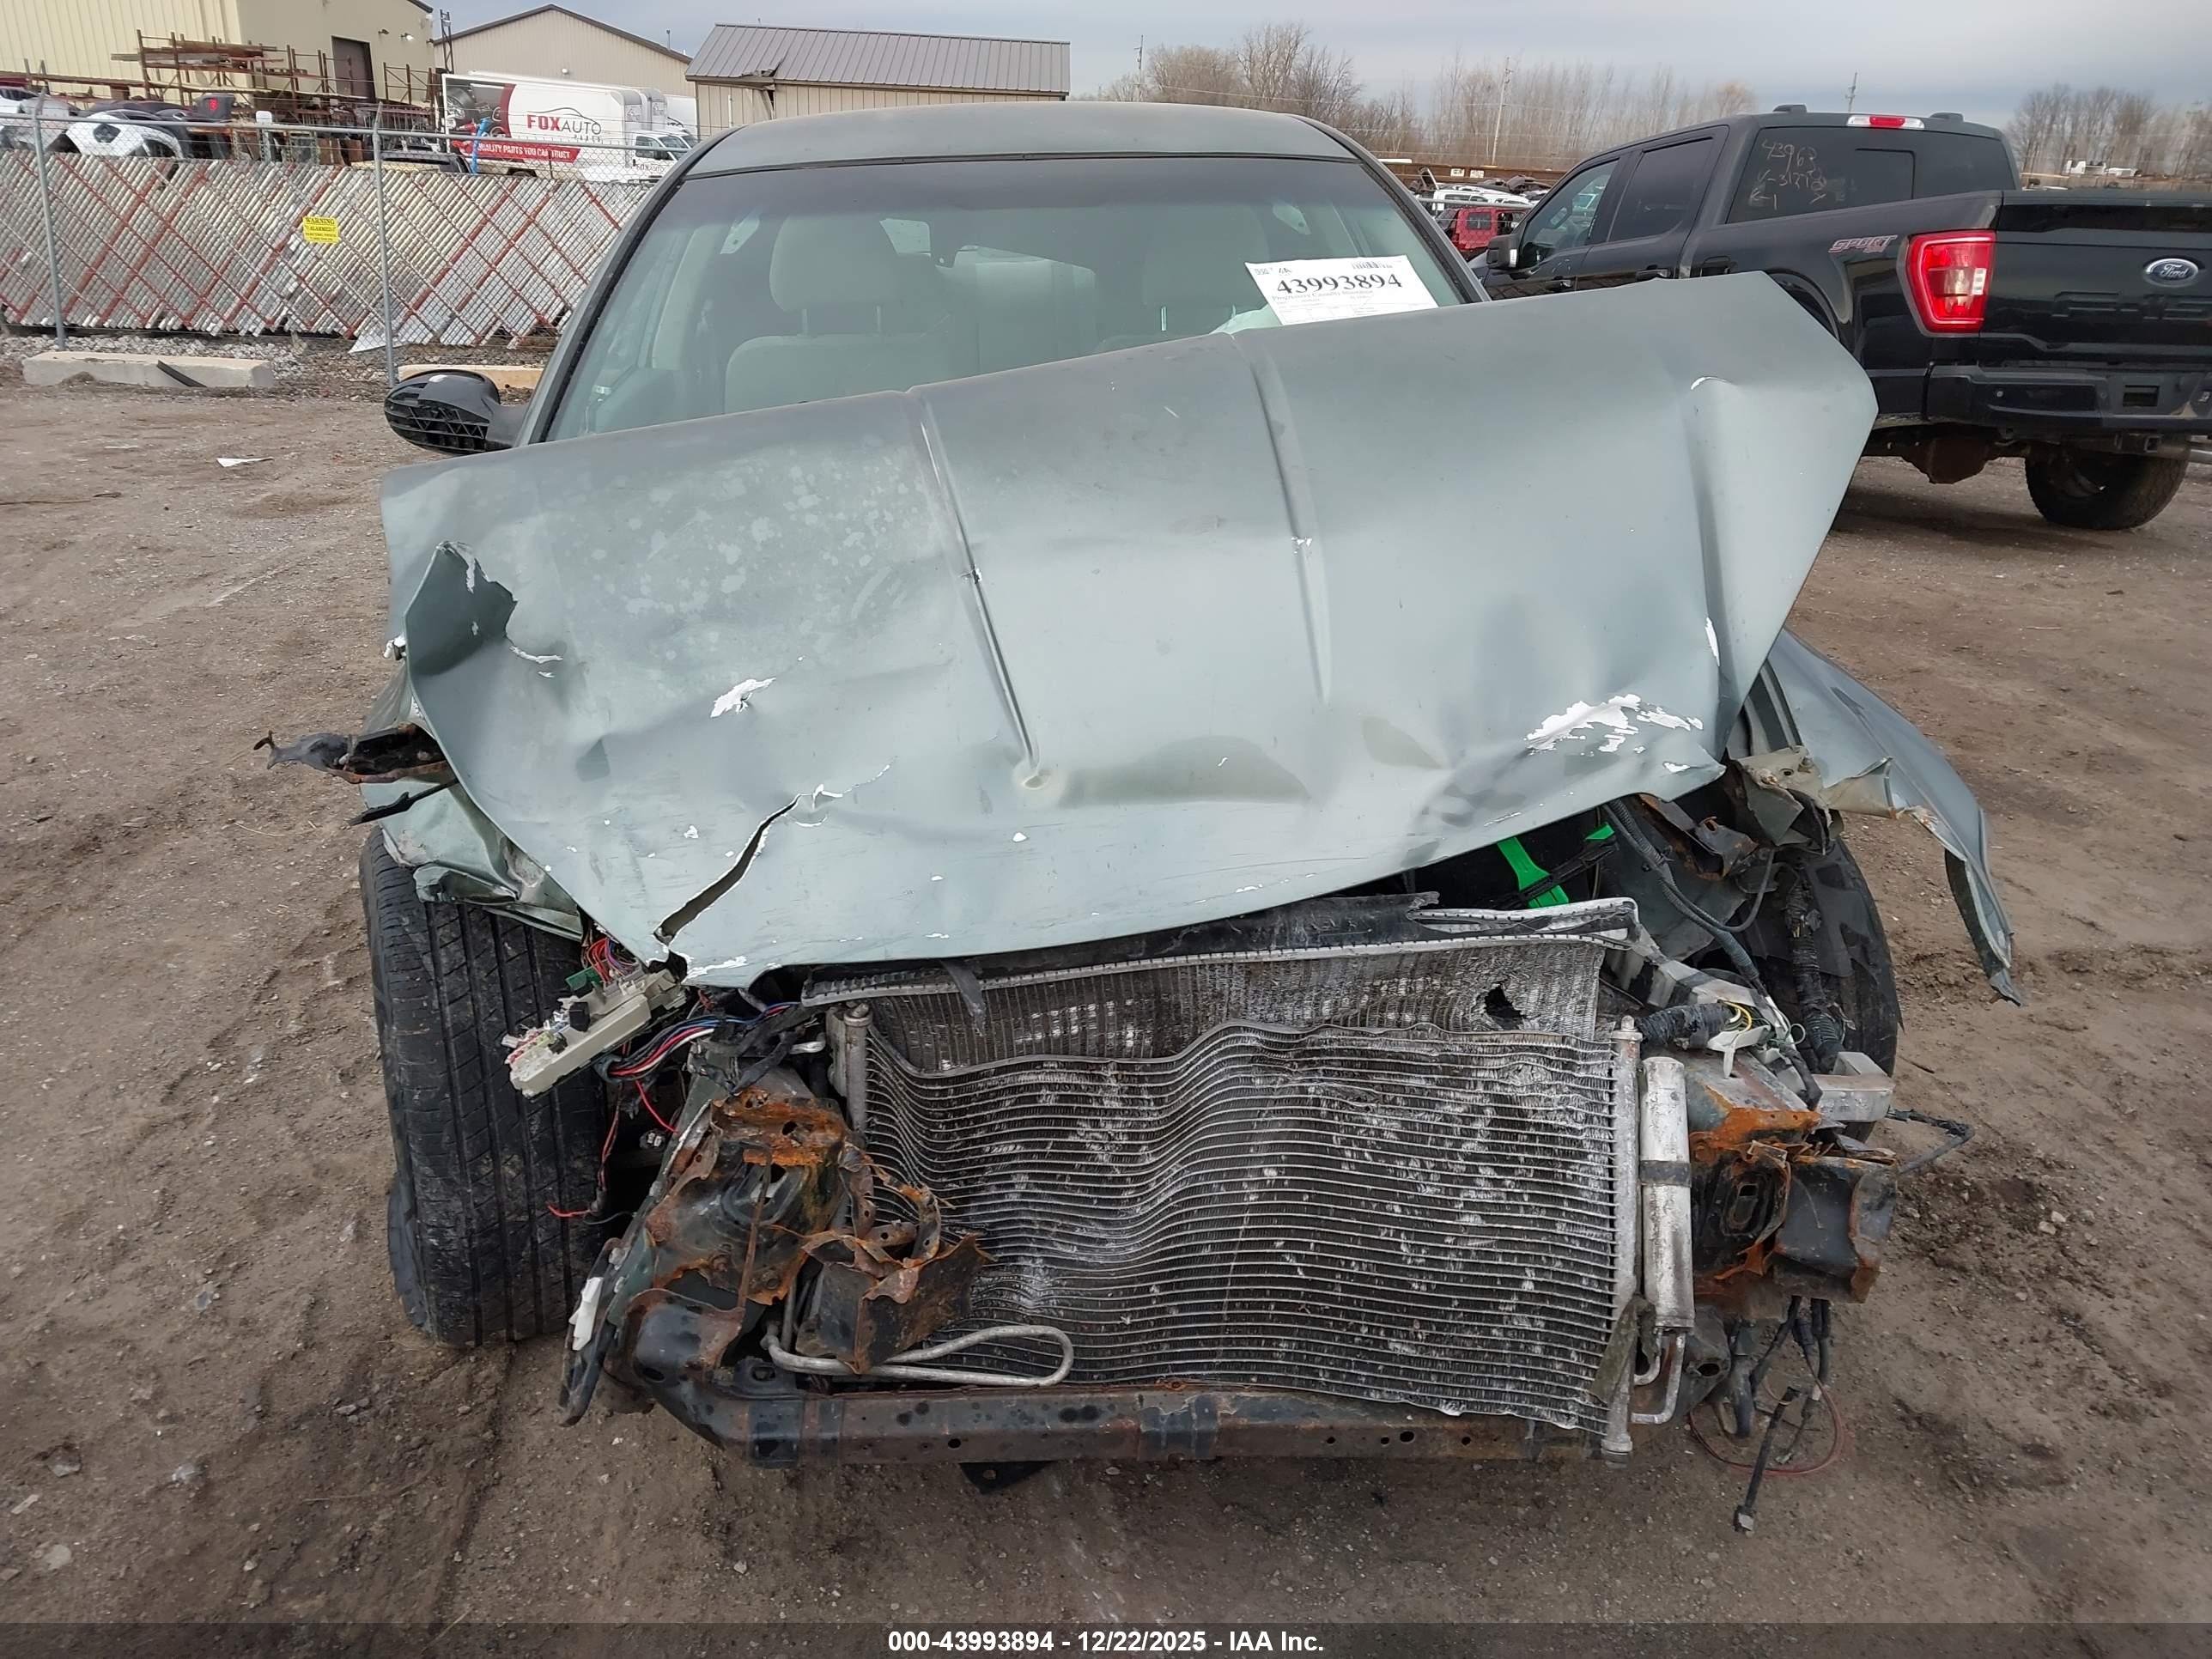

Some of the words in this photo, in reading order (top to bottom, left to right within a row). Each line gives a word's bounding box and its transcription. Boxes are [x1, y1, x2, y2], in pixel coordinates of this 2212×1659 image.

[502, 144, 524, 155] PARTS
[523, 147, 536, 155] YOU
[551, 149, 571, 159] TRUST
[1828, 234, 1899, 252] SPORT
[2160, 263, 2190, 280] Ford
[1277, 273, 1404, 294] 43993894
